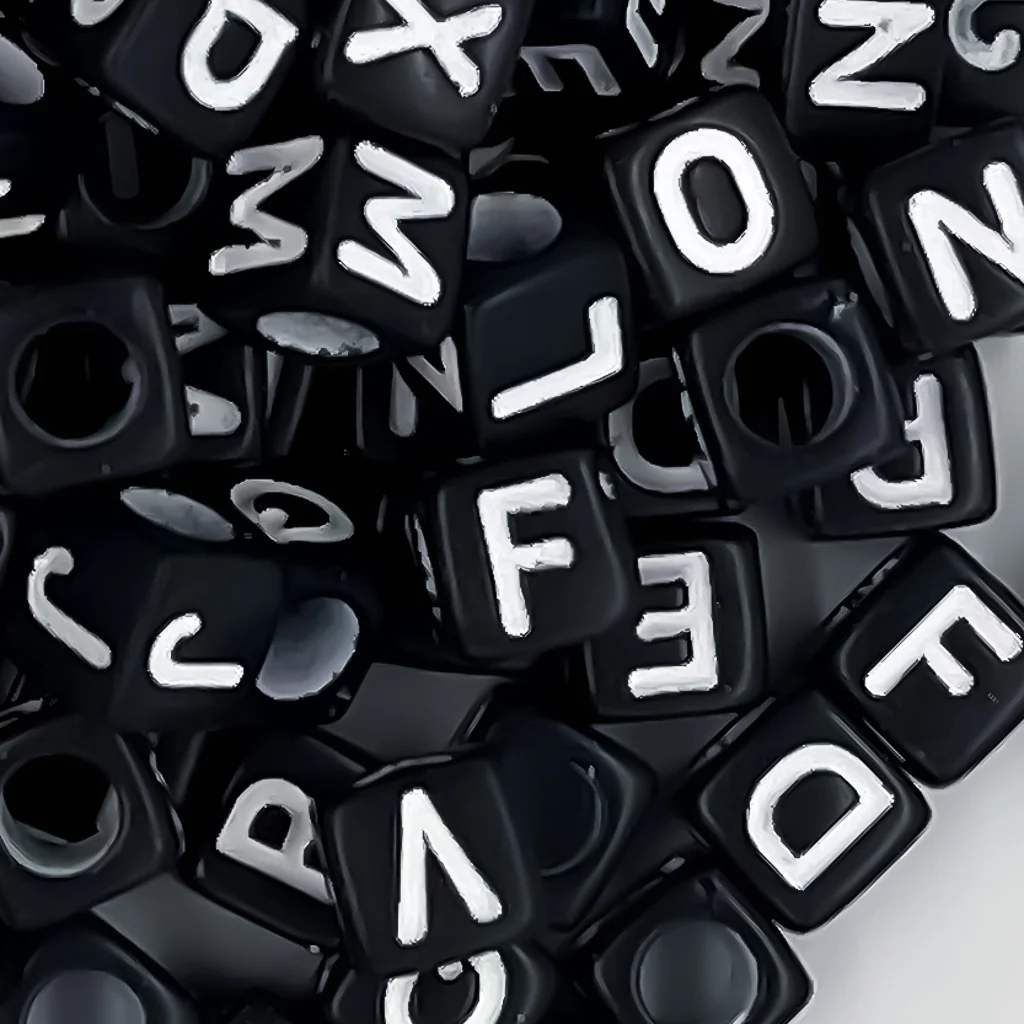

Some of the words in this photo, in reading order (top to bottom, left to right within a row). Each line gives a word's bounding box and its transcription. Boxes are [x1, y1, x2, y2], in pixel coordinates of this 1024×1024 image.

[654, 128, 774, 273] O
[492, 297, 622, 419] L
[477, 474, 573, 637] F
[628, 552, 718, 698] E
[148, 613, 244, 687] J
[865, 584, 1024, 698] F
[396, 789, 502, 945] V
[747, 744, 894, 890] D
